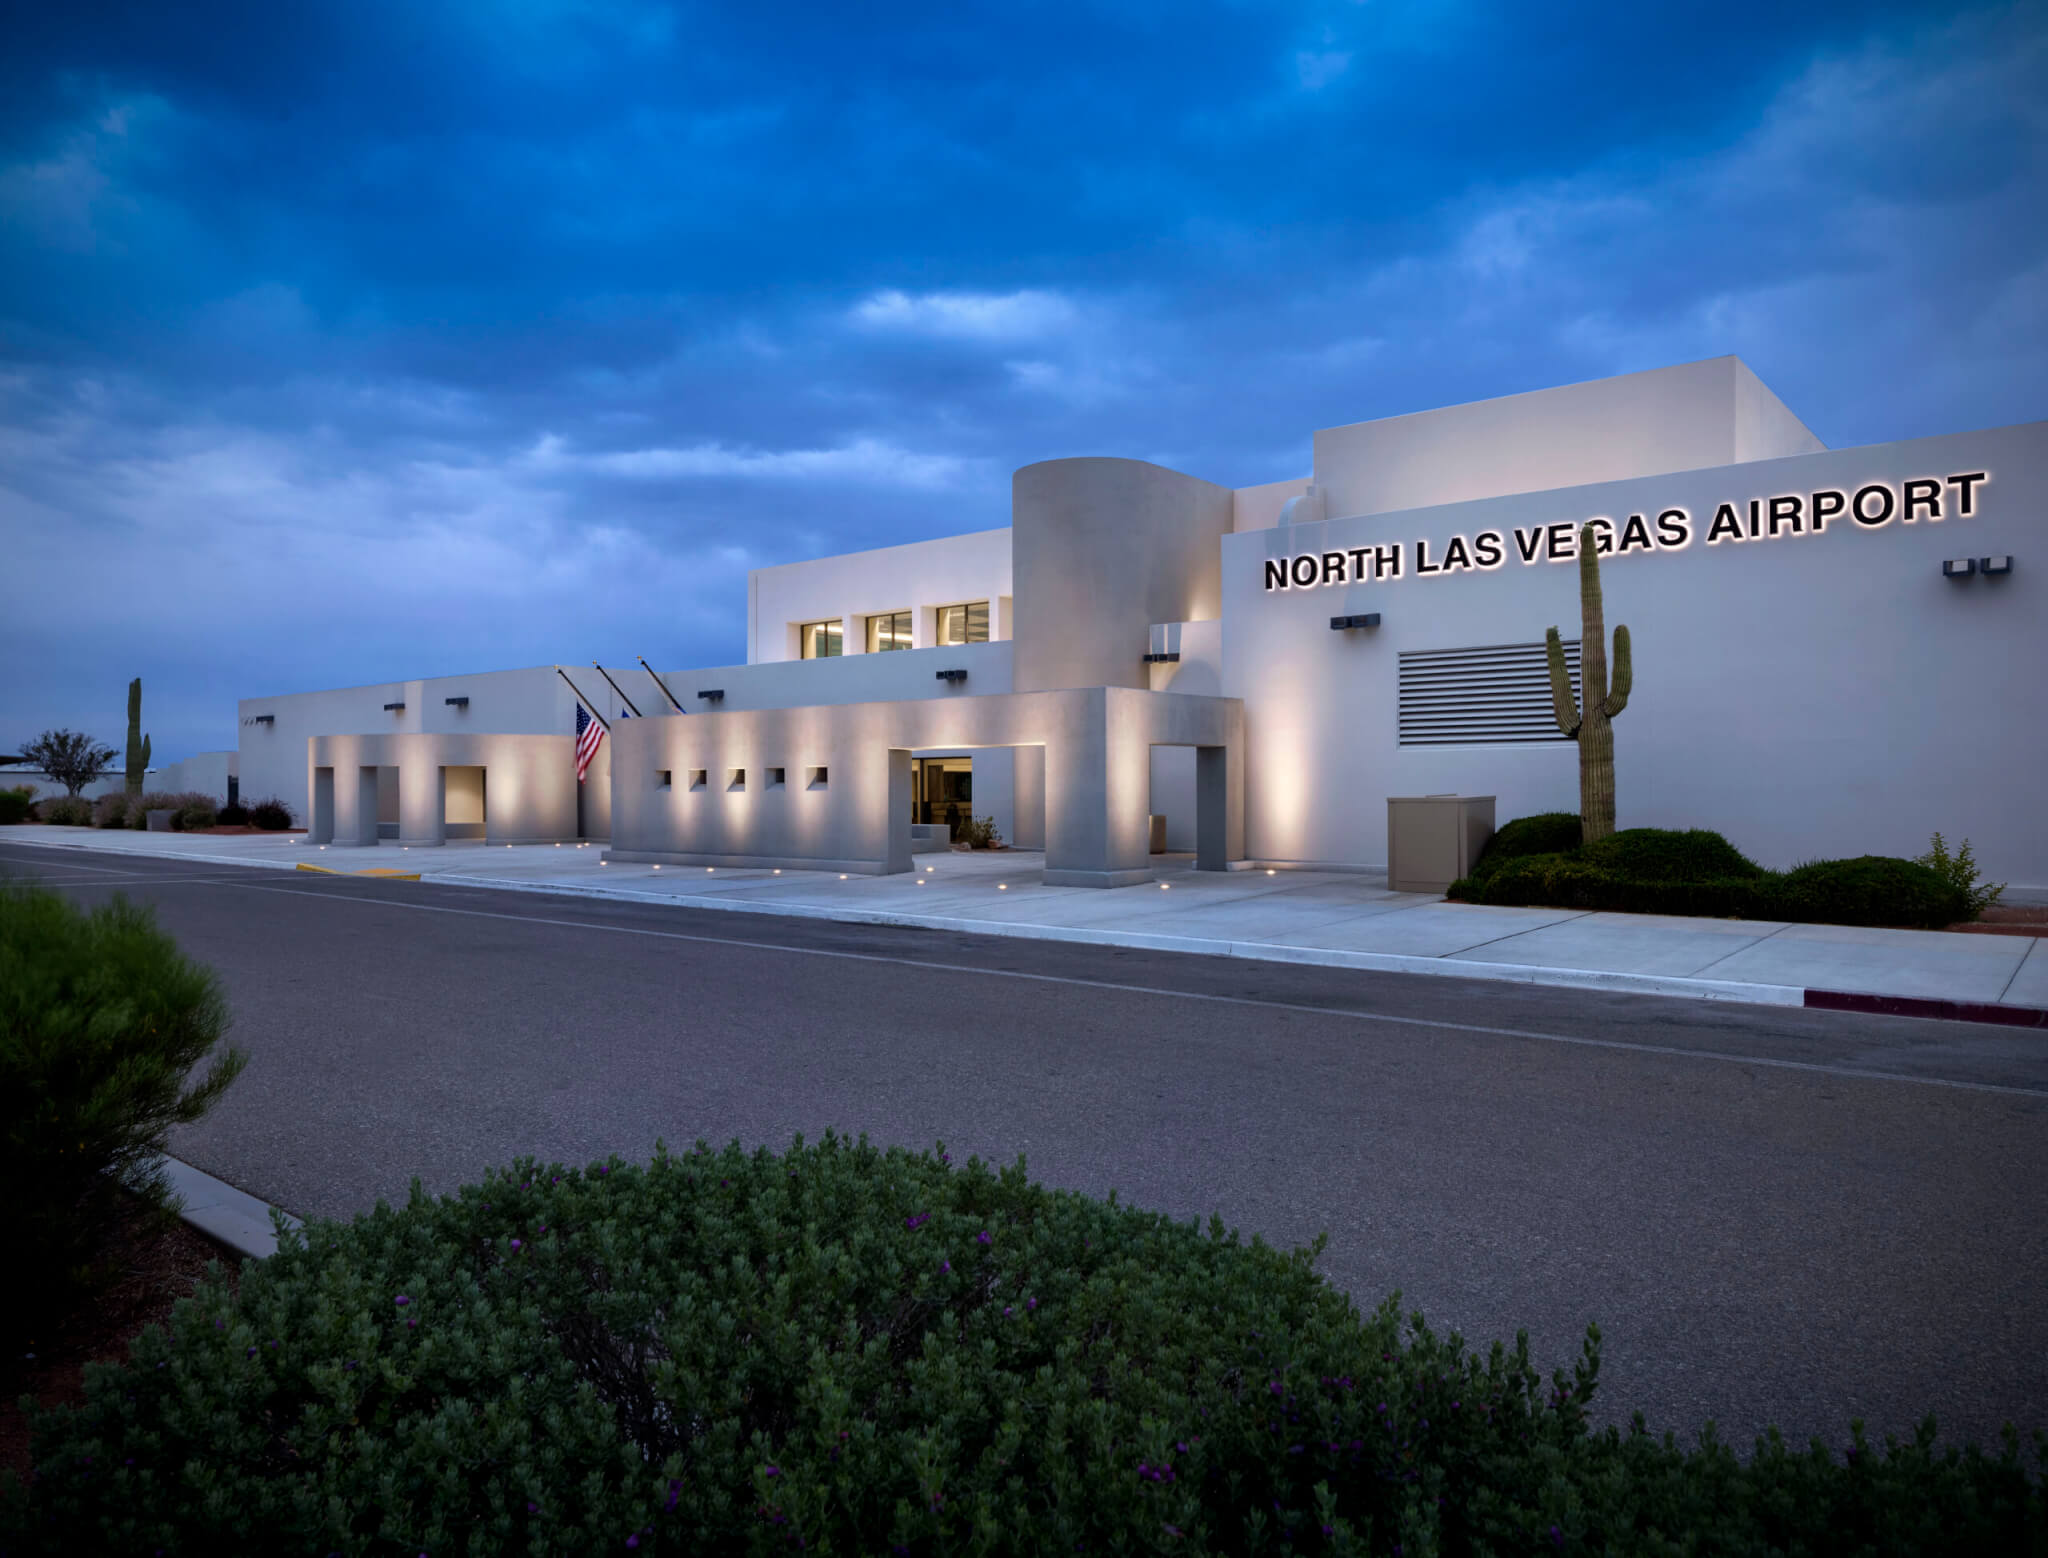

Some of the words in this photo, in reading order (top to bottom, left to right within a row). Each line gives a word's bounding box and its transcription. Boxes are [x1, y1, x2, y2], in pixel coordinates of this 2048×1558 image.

[1264, 545, 1401, 590] NORTH
[1416, 533, 1502, 574] LAS
[1513, 510, 1689, 562] VEGAS
[1707, 472, 1986, 543] AIRPORT
